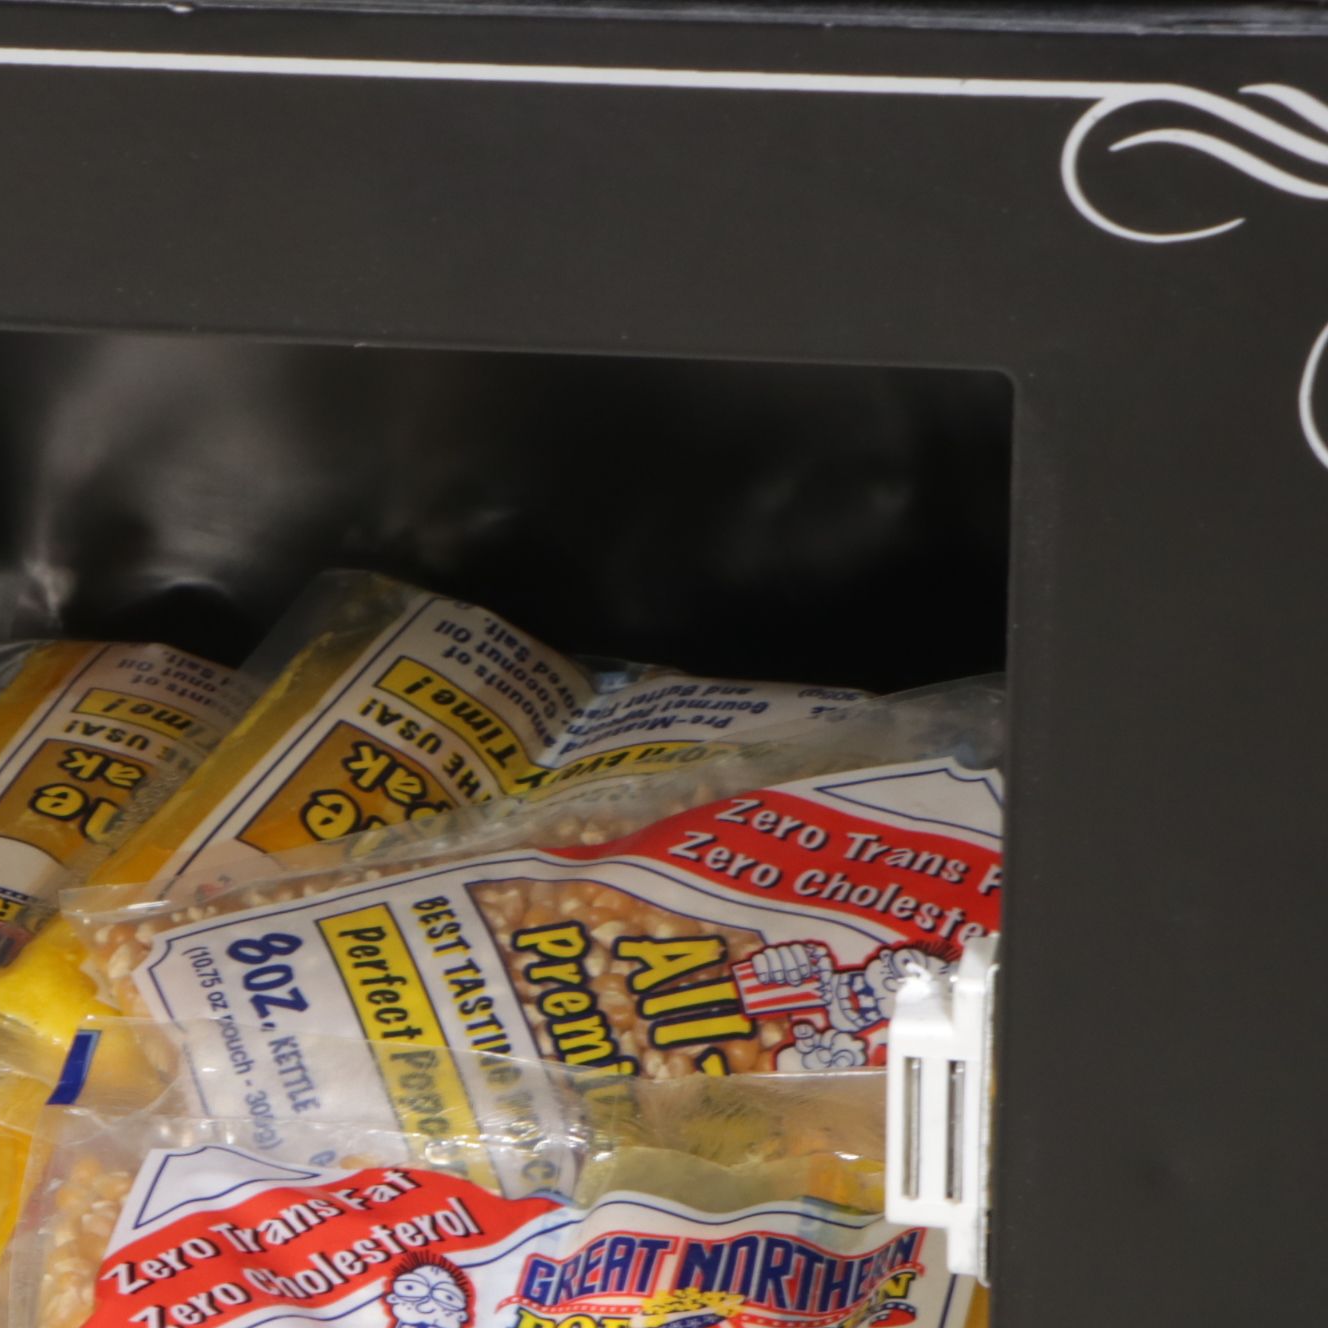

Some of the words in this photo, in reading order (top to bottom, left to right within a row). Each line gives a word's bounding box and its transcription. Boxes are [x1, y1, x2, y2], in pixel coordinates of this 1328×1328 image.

[435, 620, 471, 643] Oil
[442, 646, 471, 665] of
[359, 699, 443, 756] USA!
[58, 747, 145, 790] ak
[715, 799, 830, 852] Zero
[842, 832, 972, 886] Trans
[667, 829, 783, 890] Zero
[792, 867, 986, 945] Choleste
[411, 894, 473, 957] BEST
[338, 926, 425, 1041] Perfect
[102, 1236, 219, 1295] Zero
[209, 1198, 345, 1255] Trans
[334, 1169, 424, 1212] Fat
[243, 1197, 483, 1298] Cholesterol
[518, 1232, 674, 1306] GREAT
